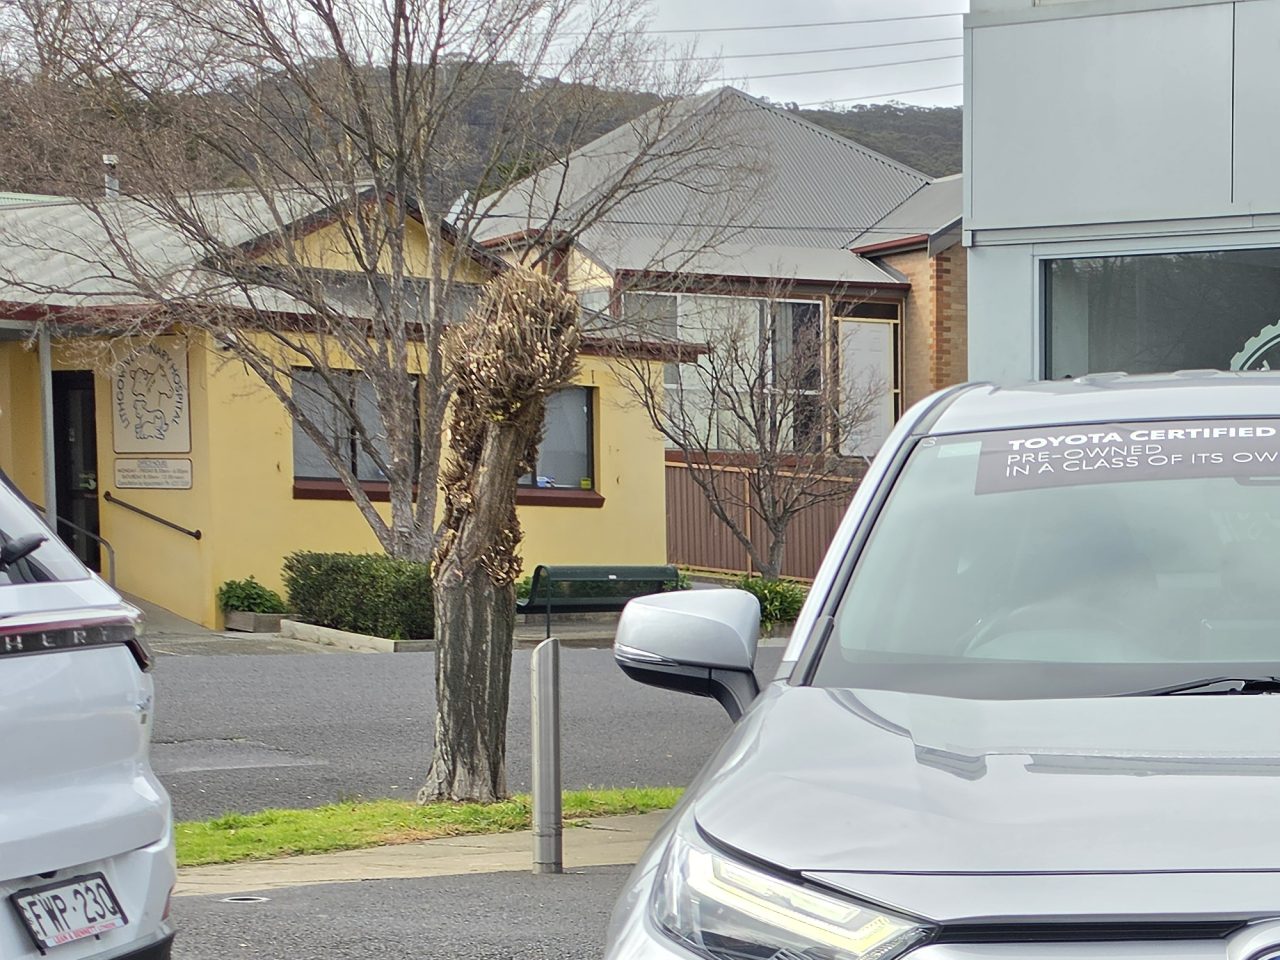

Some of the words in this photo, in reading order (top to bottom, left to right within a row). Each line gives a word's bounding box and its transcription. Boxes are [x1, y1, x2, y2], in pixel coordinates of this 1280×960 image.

[1008, 432, 1124, 451] TOYOTA
[1129, 426, 1277, 442] CERTIFIED
[1006, 464, 1030, 478] IN
[1037, 461, 1055, 475] A
[1062, 456, 1139, 472] CLASS
[1147, 453, 1184, 467] OF
[1191, 452, 1224, 465] ITS
[1007, 443, 1162, 466] PRE-OWNED
